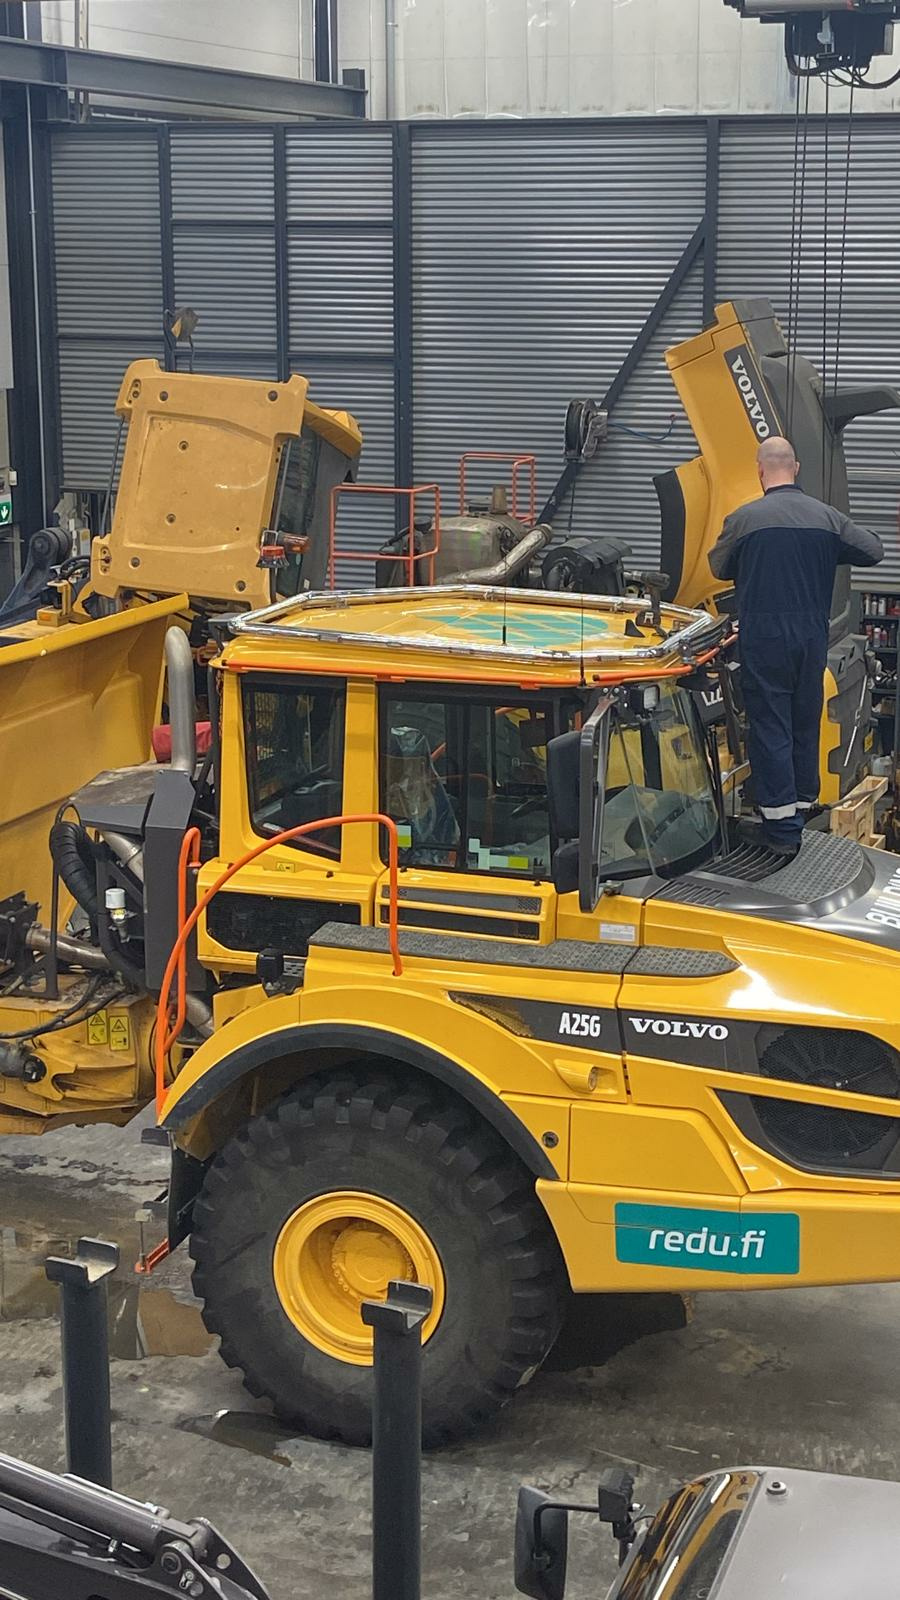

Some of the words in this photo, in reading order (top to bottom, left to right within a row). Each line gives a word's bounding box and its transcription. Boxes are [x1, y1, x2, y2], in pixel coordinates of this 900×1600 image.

[731, 354, 770, 437] VOLVO
[558, 1012, 600, 1038] A25G
[628, 1017, 729, 1041] VOLVO
[648, 1227, 767, 1259] redu.fi
